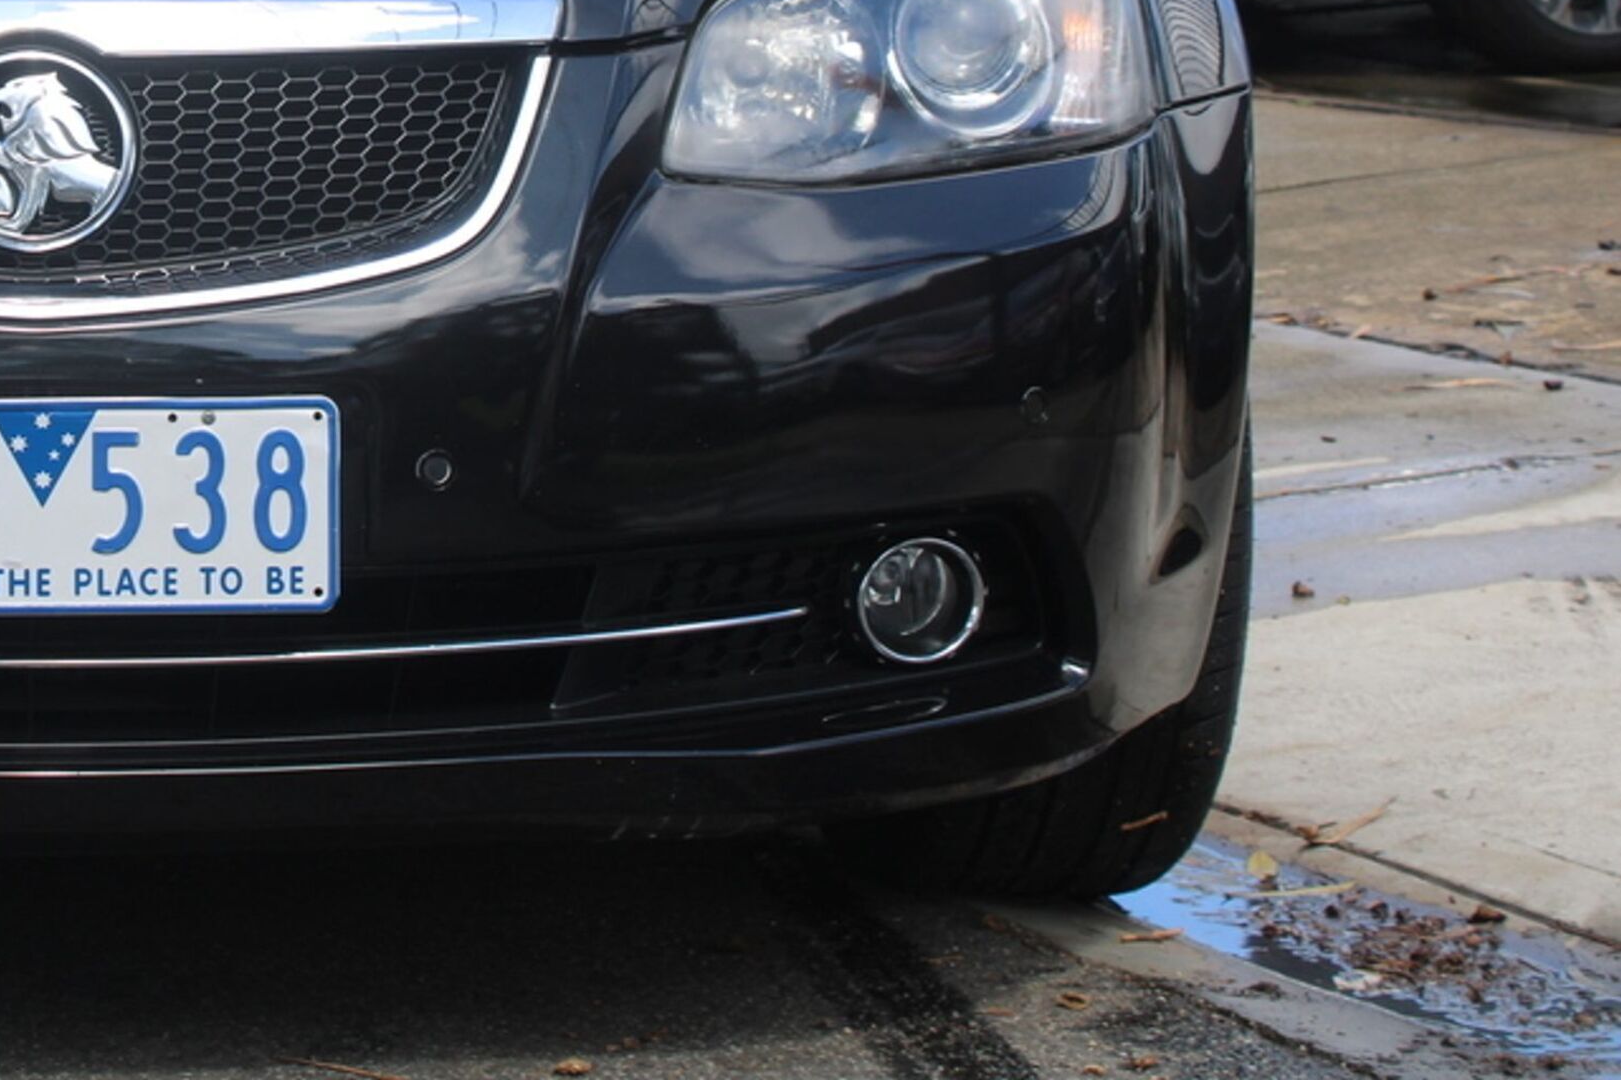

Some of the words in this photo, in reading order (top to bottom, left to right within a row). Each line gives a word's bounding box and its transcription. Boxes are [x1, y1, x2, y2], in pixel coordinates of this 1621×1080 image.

[90, 429, 308, 554] 538
[73, 568, 179, 596] PLACE
[199, 567, 243, 595] TO
[266, 566, 305, 595] BE
